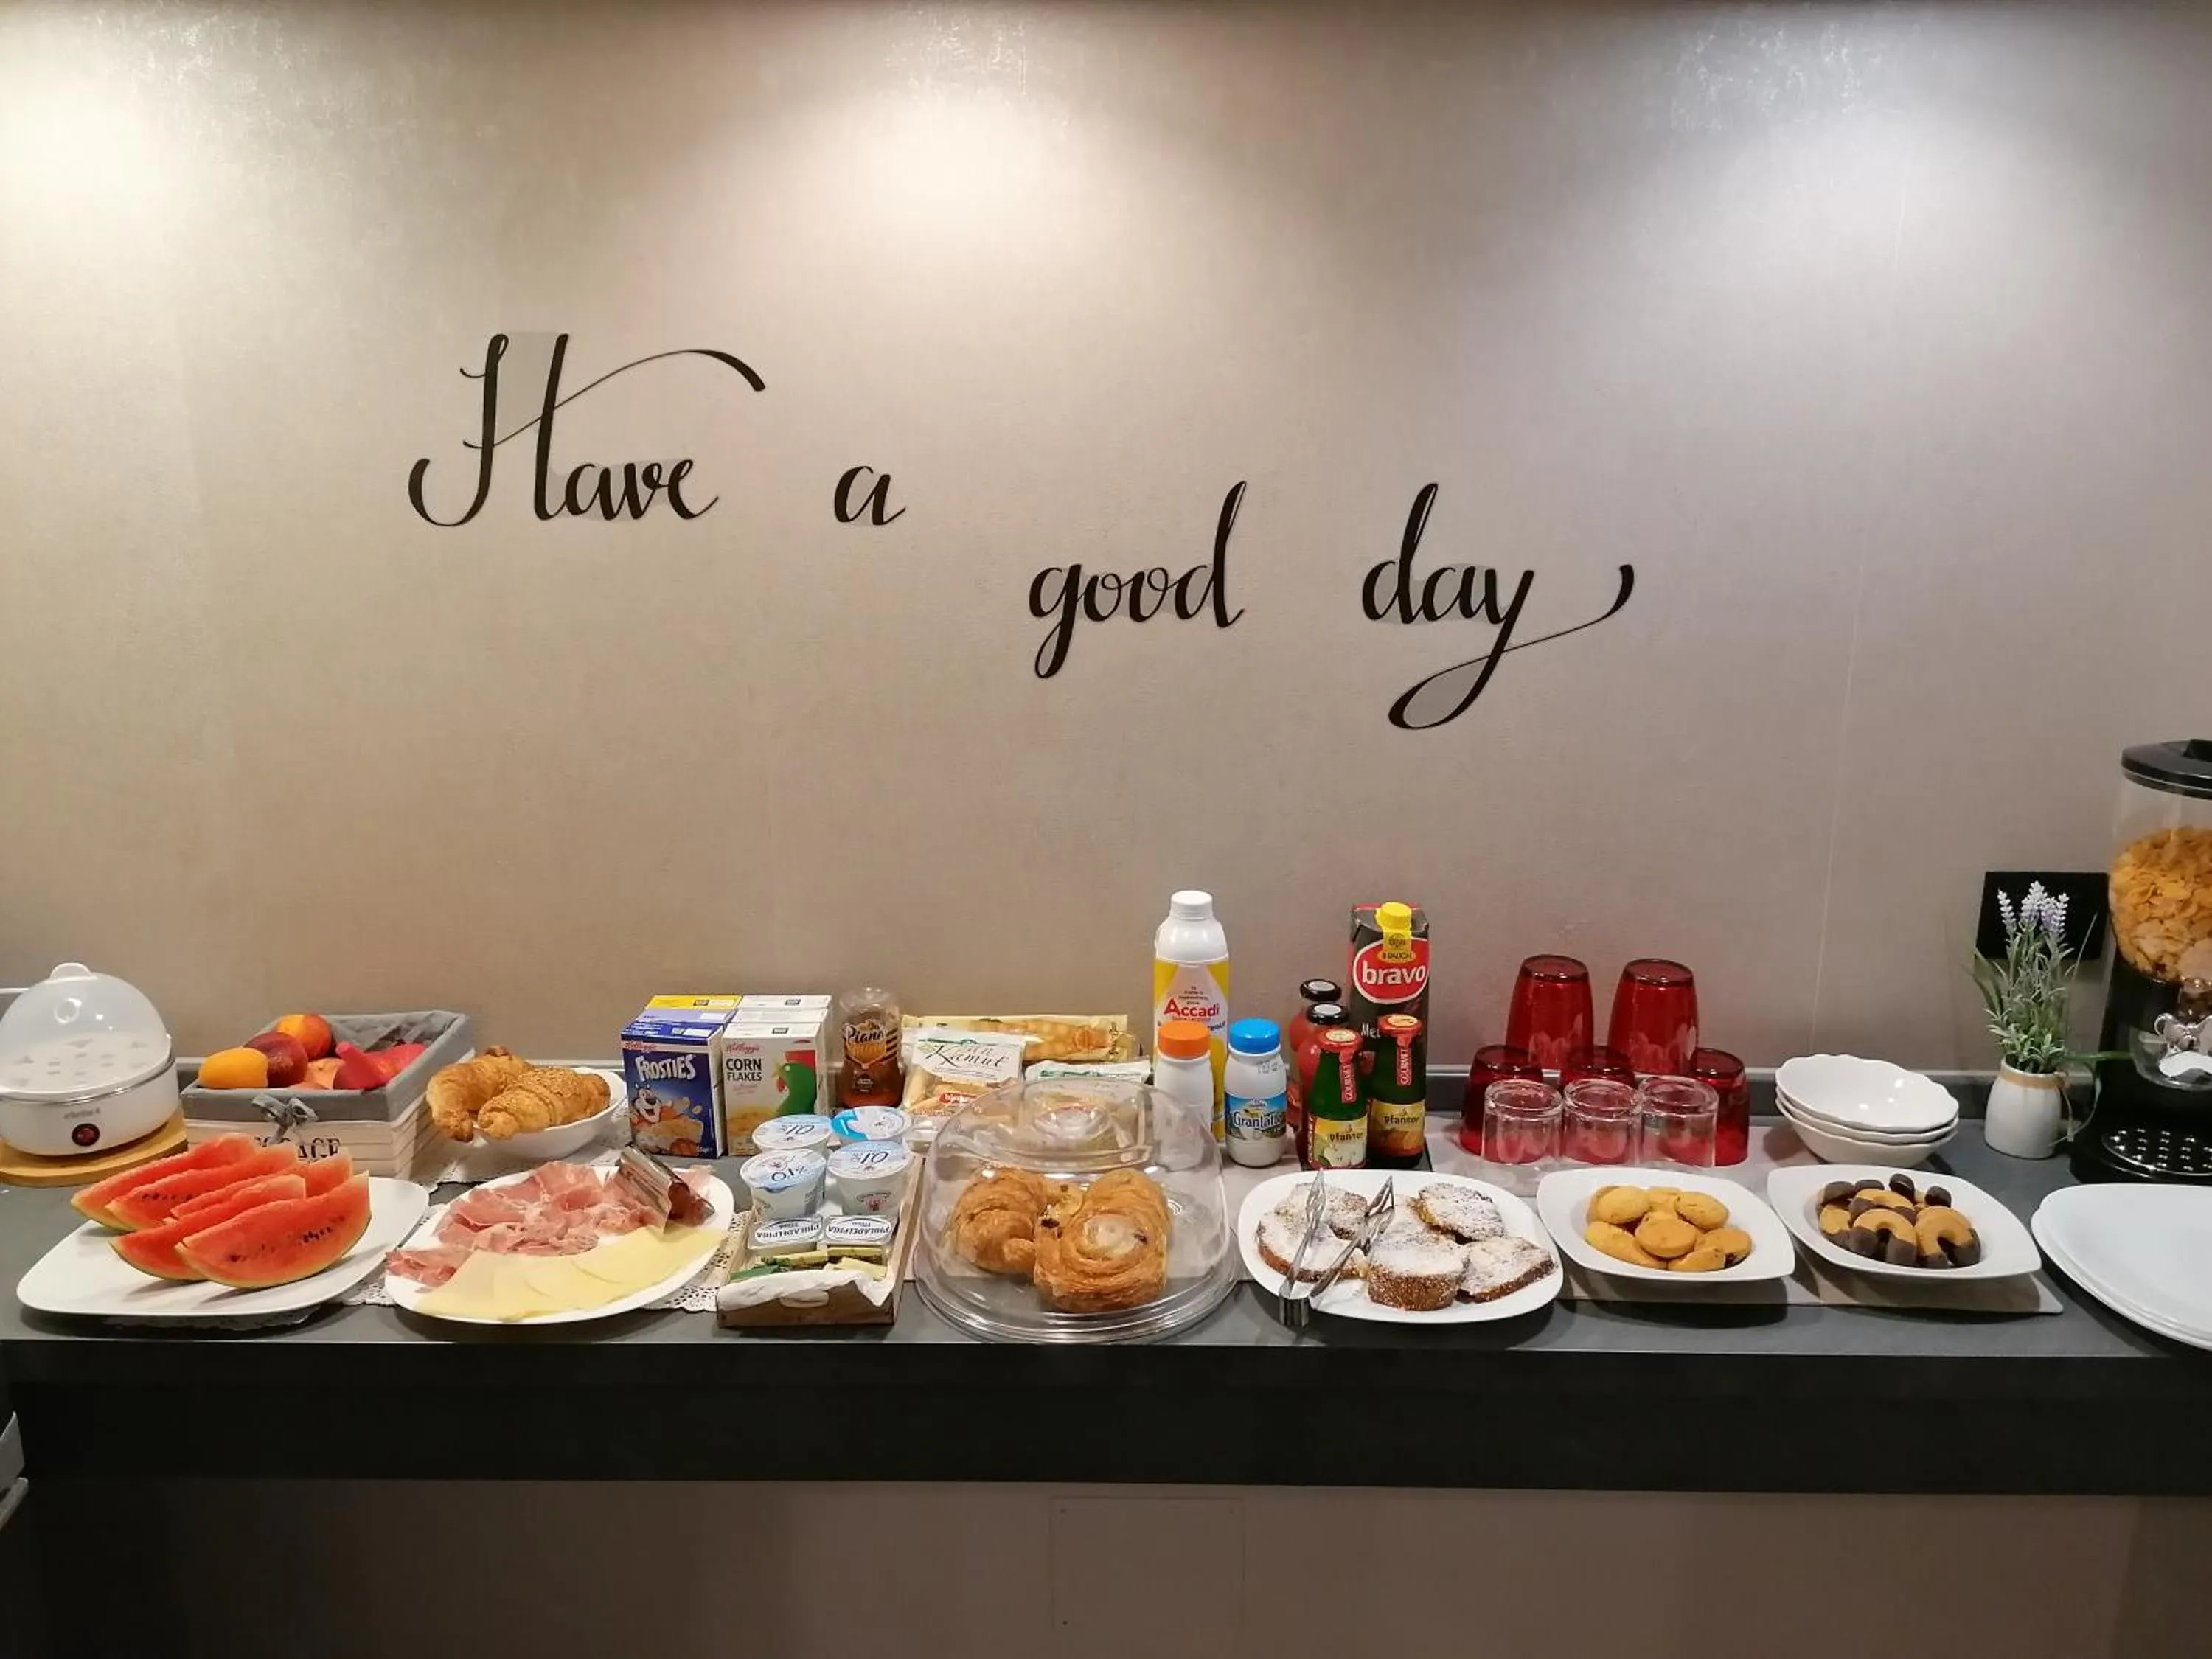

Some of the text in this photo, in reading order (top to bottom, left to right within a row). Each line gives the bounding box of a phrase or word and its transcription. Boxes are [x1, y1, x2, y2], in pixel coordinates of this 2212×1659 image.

[408, 332, 906, 527] Have a
[1029, 481, 1634, 729] good day
[1362, 961, 1427, 985] bravo
[635, 1054, 696, 1082] FROSTIES
[726, 1058, 762, 1071] CORN
[727, 1071, 762, 1082] FLAKES
